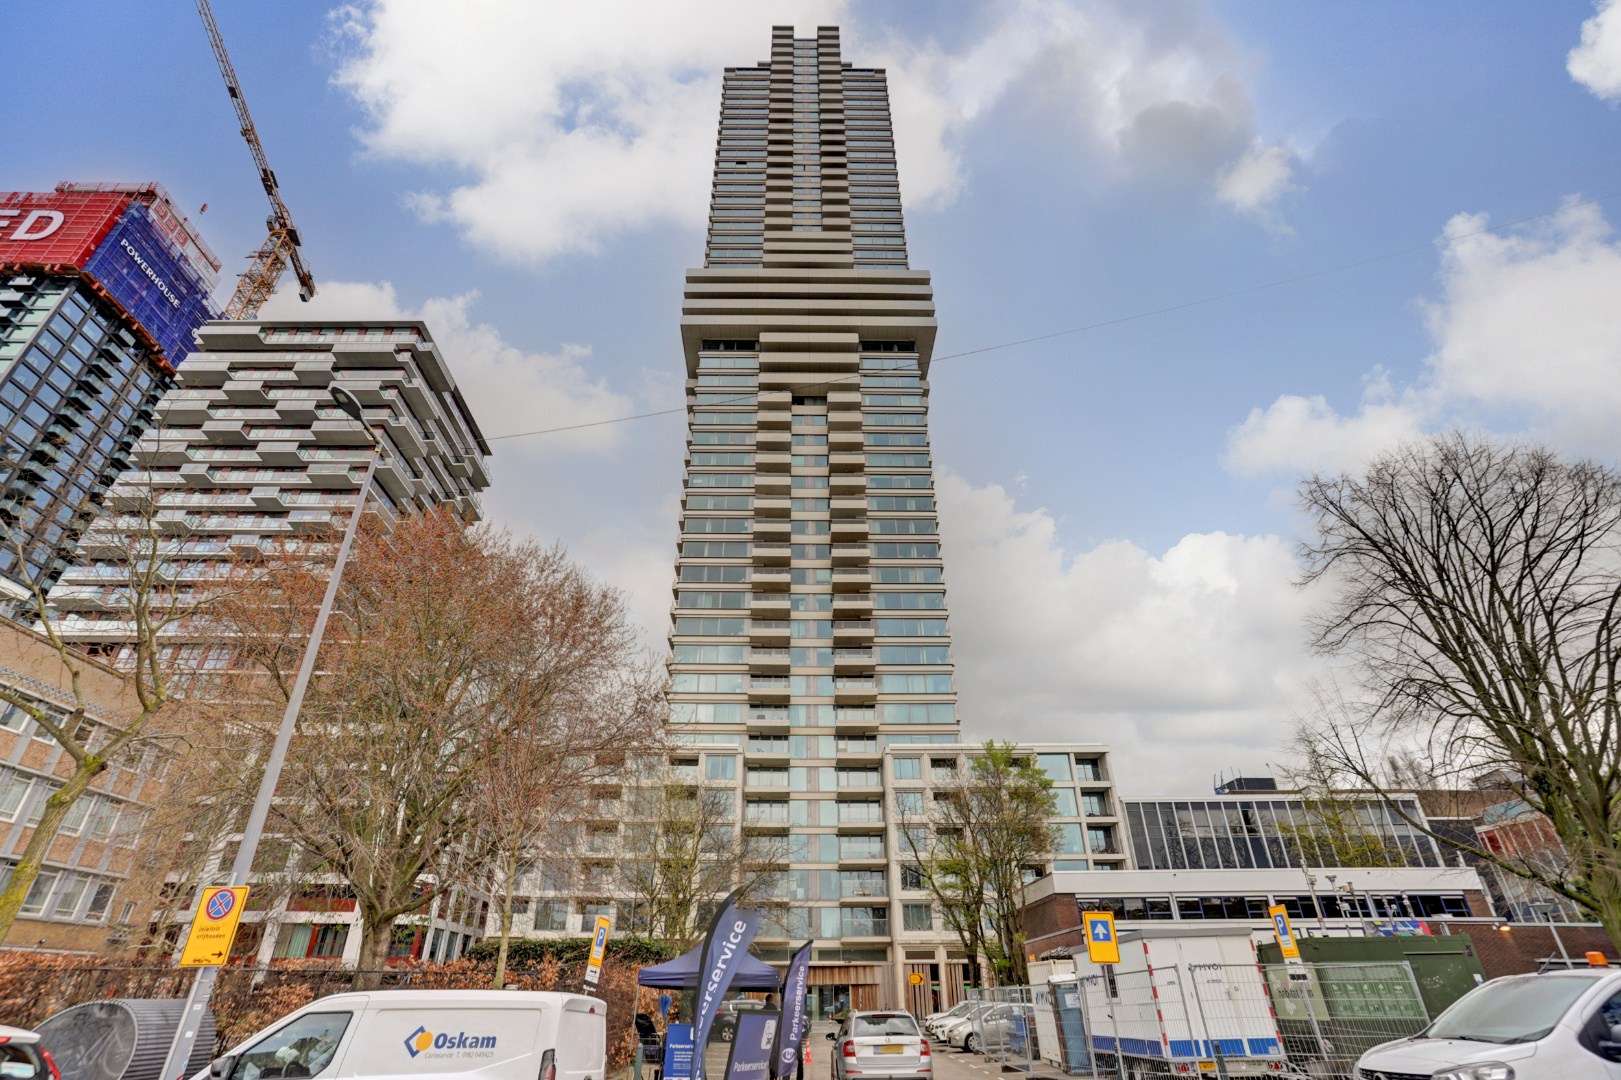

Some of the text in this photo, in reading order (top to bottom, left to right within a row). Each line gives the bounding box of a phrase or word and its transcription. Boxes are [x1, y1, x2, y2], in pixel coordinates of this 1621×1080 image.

[120, 238, 181, 309] POWERHOUSE
[790, 965, 805, 1041] Parkeerservice
[434, 1032, 497, 1050] Oskam
